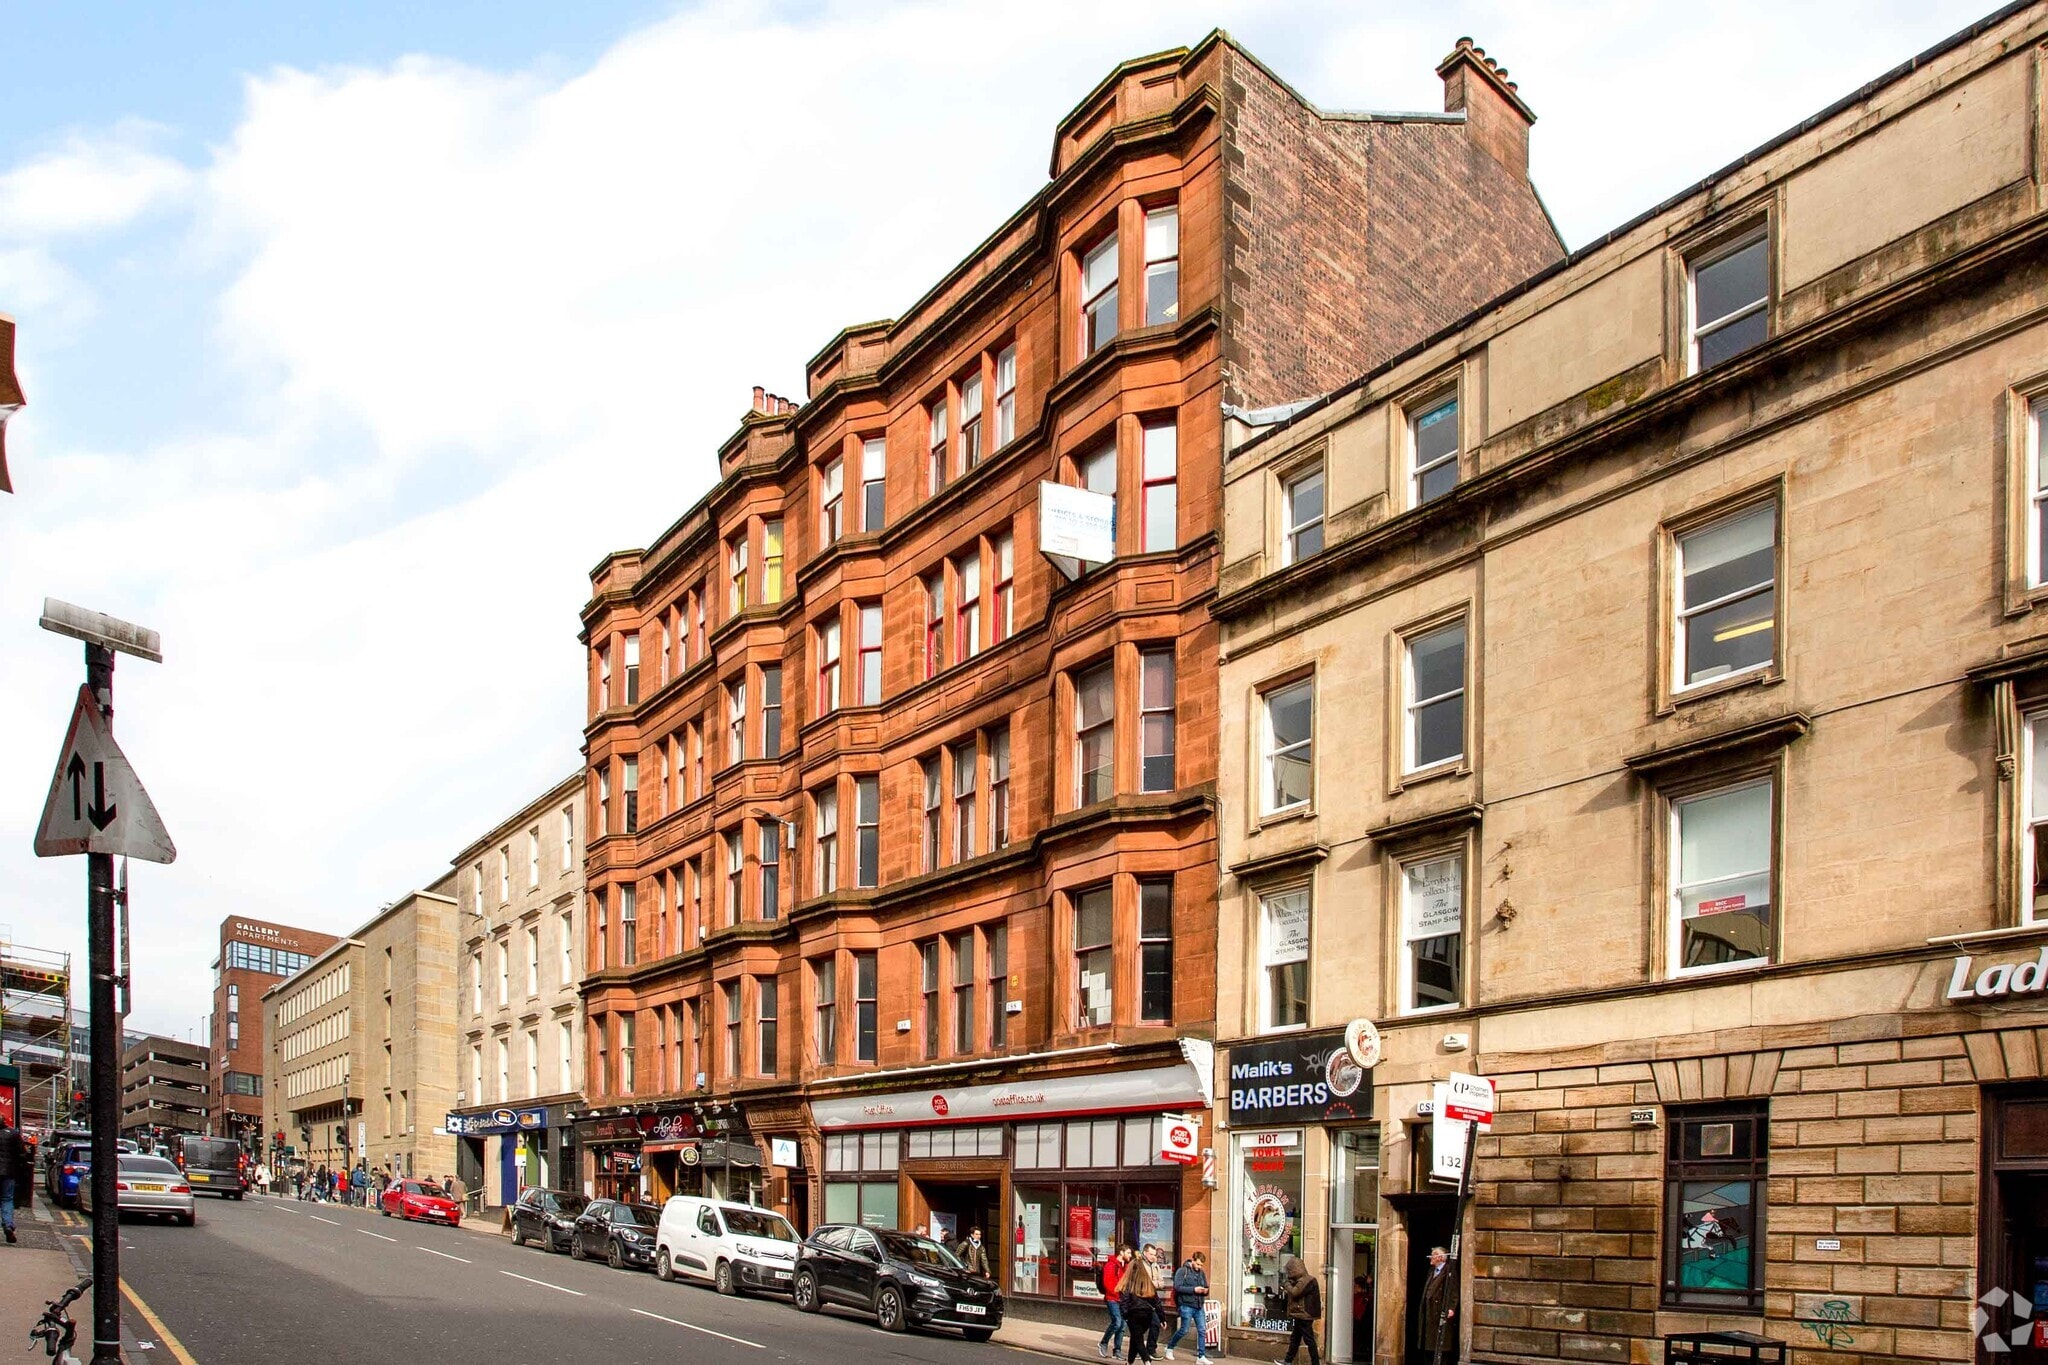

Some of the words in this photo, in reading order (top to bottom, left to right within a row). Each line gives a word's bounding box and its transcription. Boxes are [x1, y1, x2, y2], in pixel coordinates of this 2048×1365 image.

[1422, 906, 1459, 918] GLASGOW
[1418, 919, 1442, 928] STAMP
[1443, 914, 1461, 923] SHO
[236, 922, 280, 936] GALLERY
[236, 930, 298, 947] APARTMENTS
[1232, 1060, 1293, 1080] Malik's
[992, 1092, 1044, 1106] postoffice.co.uk
[1231, 1082, 1328, 1110] BARBERS
[230, 1113, 248, 1122] ASK
[1172, 1136, 1190, 1144] OFFICE
[1174, 1129, 1188, 1138] POST
[1258, 1134, 1278, 1144] HOT
[1252, 1146, 1285, 1158] TOWEL
[1442, 1155, 1461, 1168] 132
[1248, 1184, 1289, 1206] TURKISH
